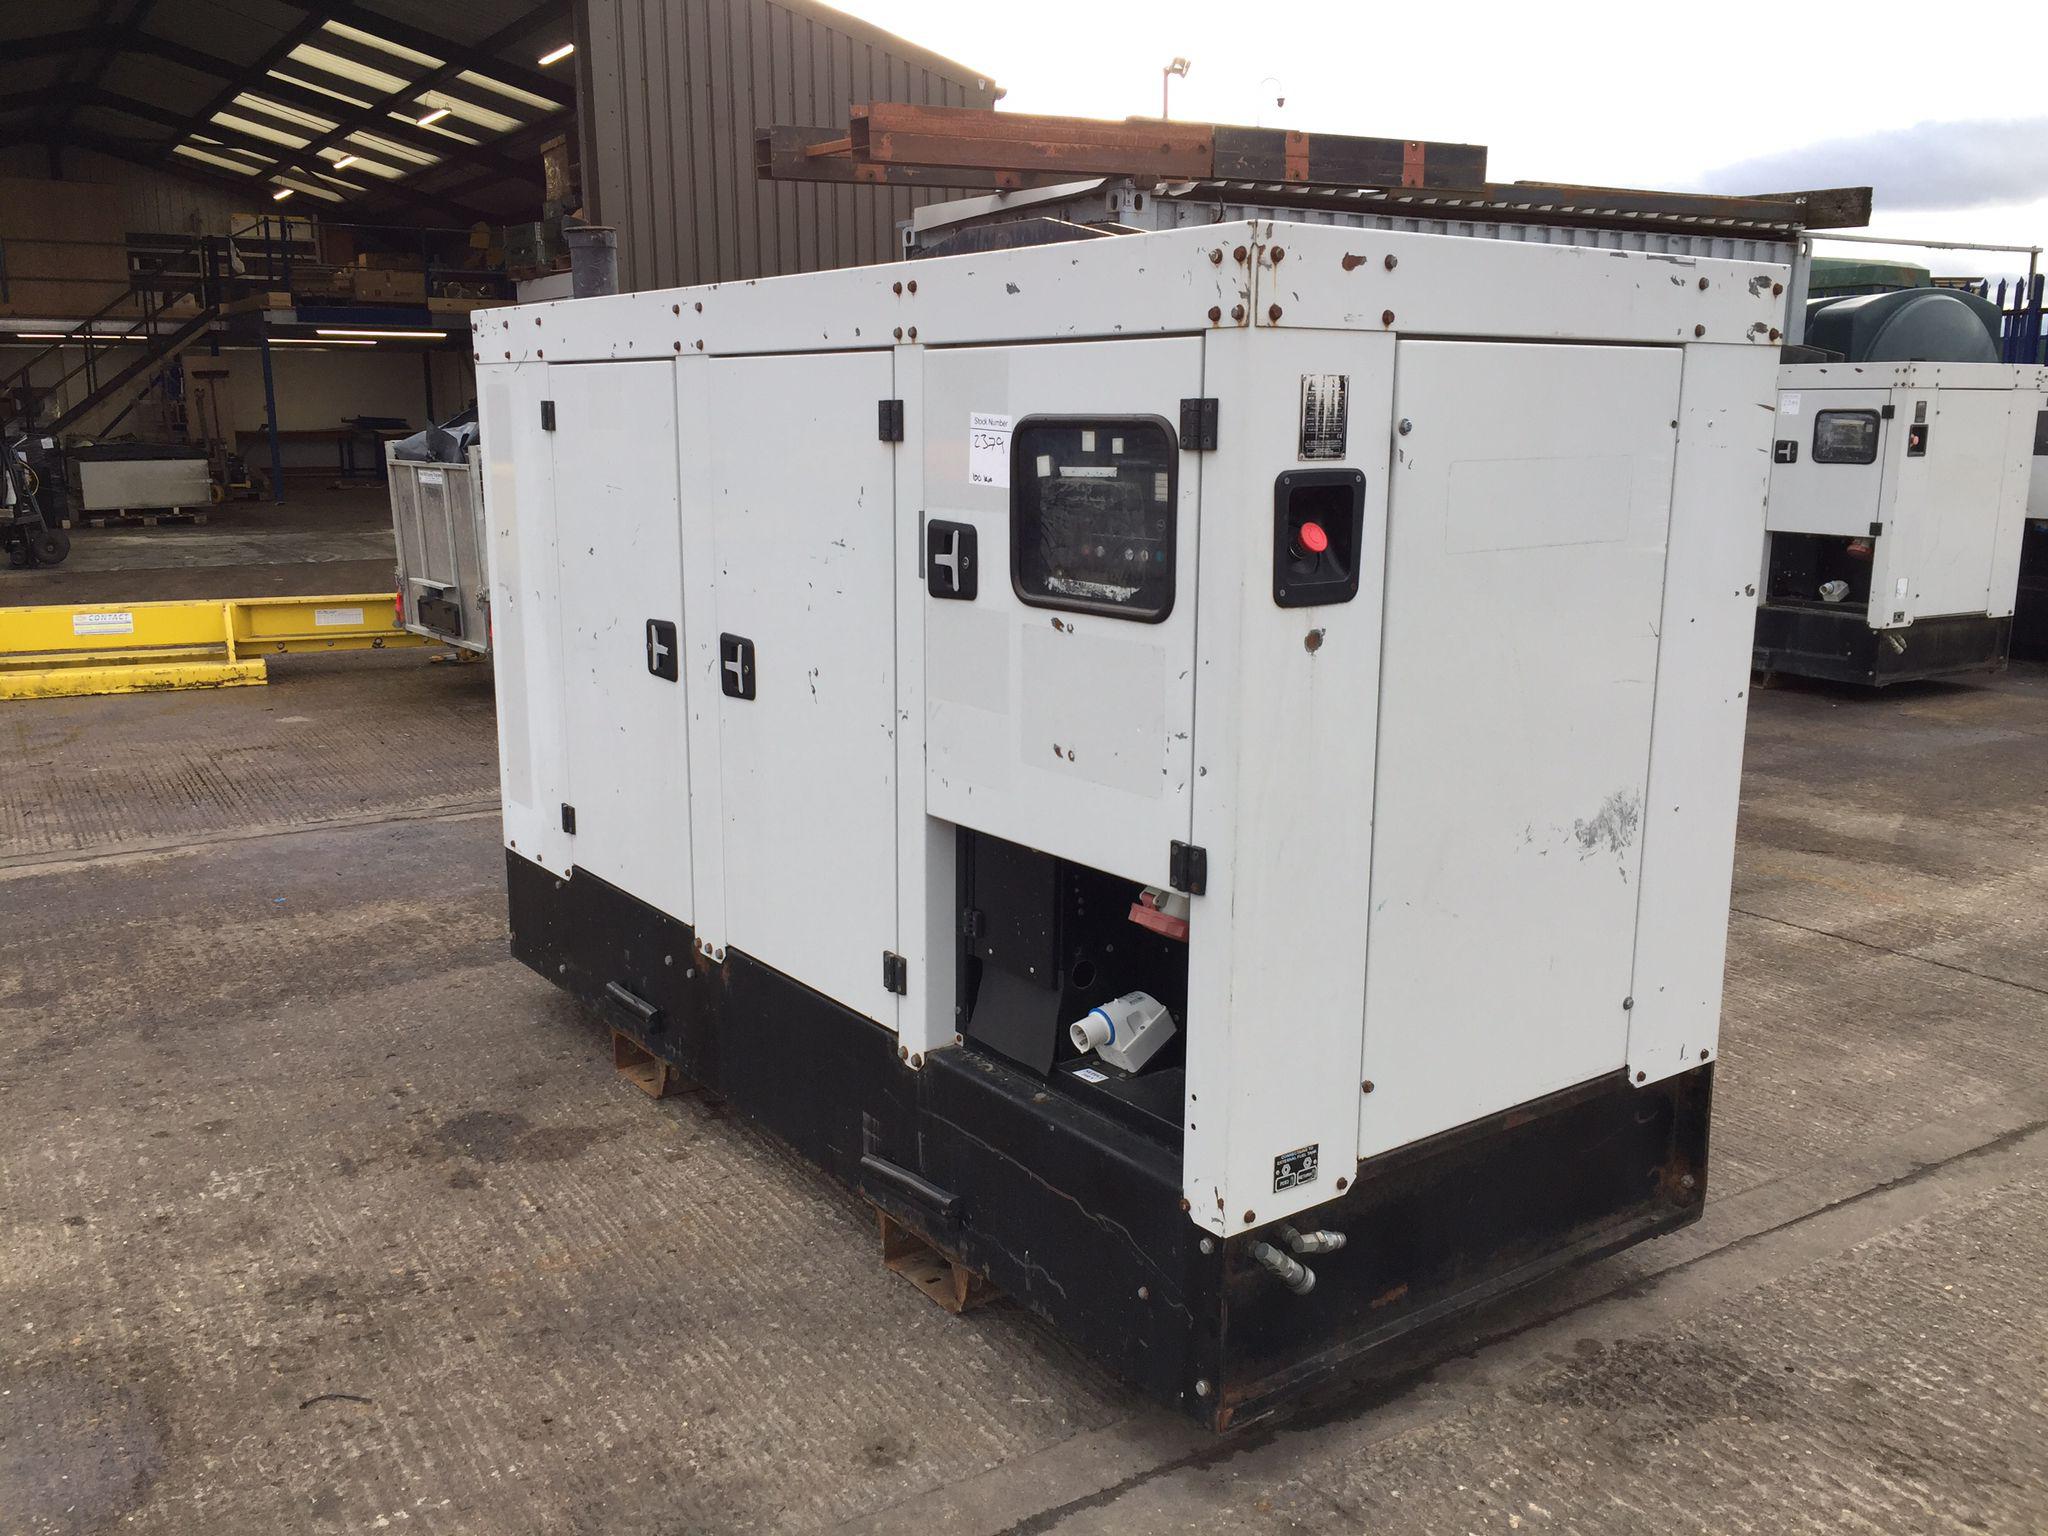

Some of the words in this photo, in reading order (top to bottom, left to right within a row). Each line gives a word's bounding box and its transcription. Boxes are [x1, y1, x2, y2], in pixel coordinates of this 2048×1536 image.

[974, 417, 987, 425] Stock
[989, 419, 1008, 428] Number
[974, 434, 1004, 454] 2379
[88, 614, 128, 622] CONTACT
